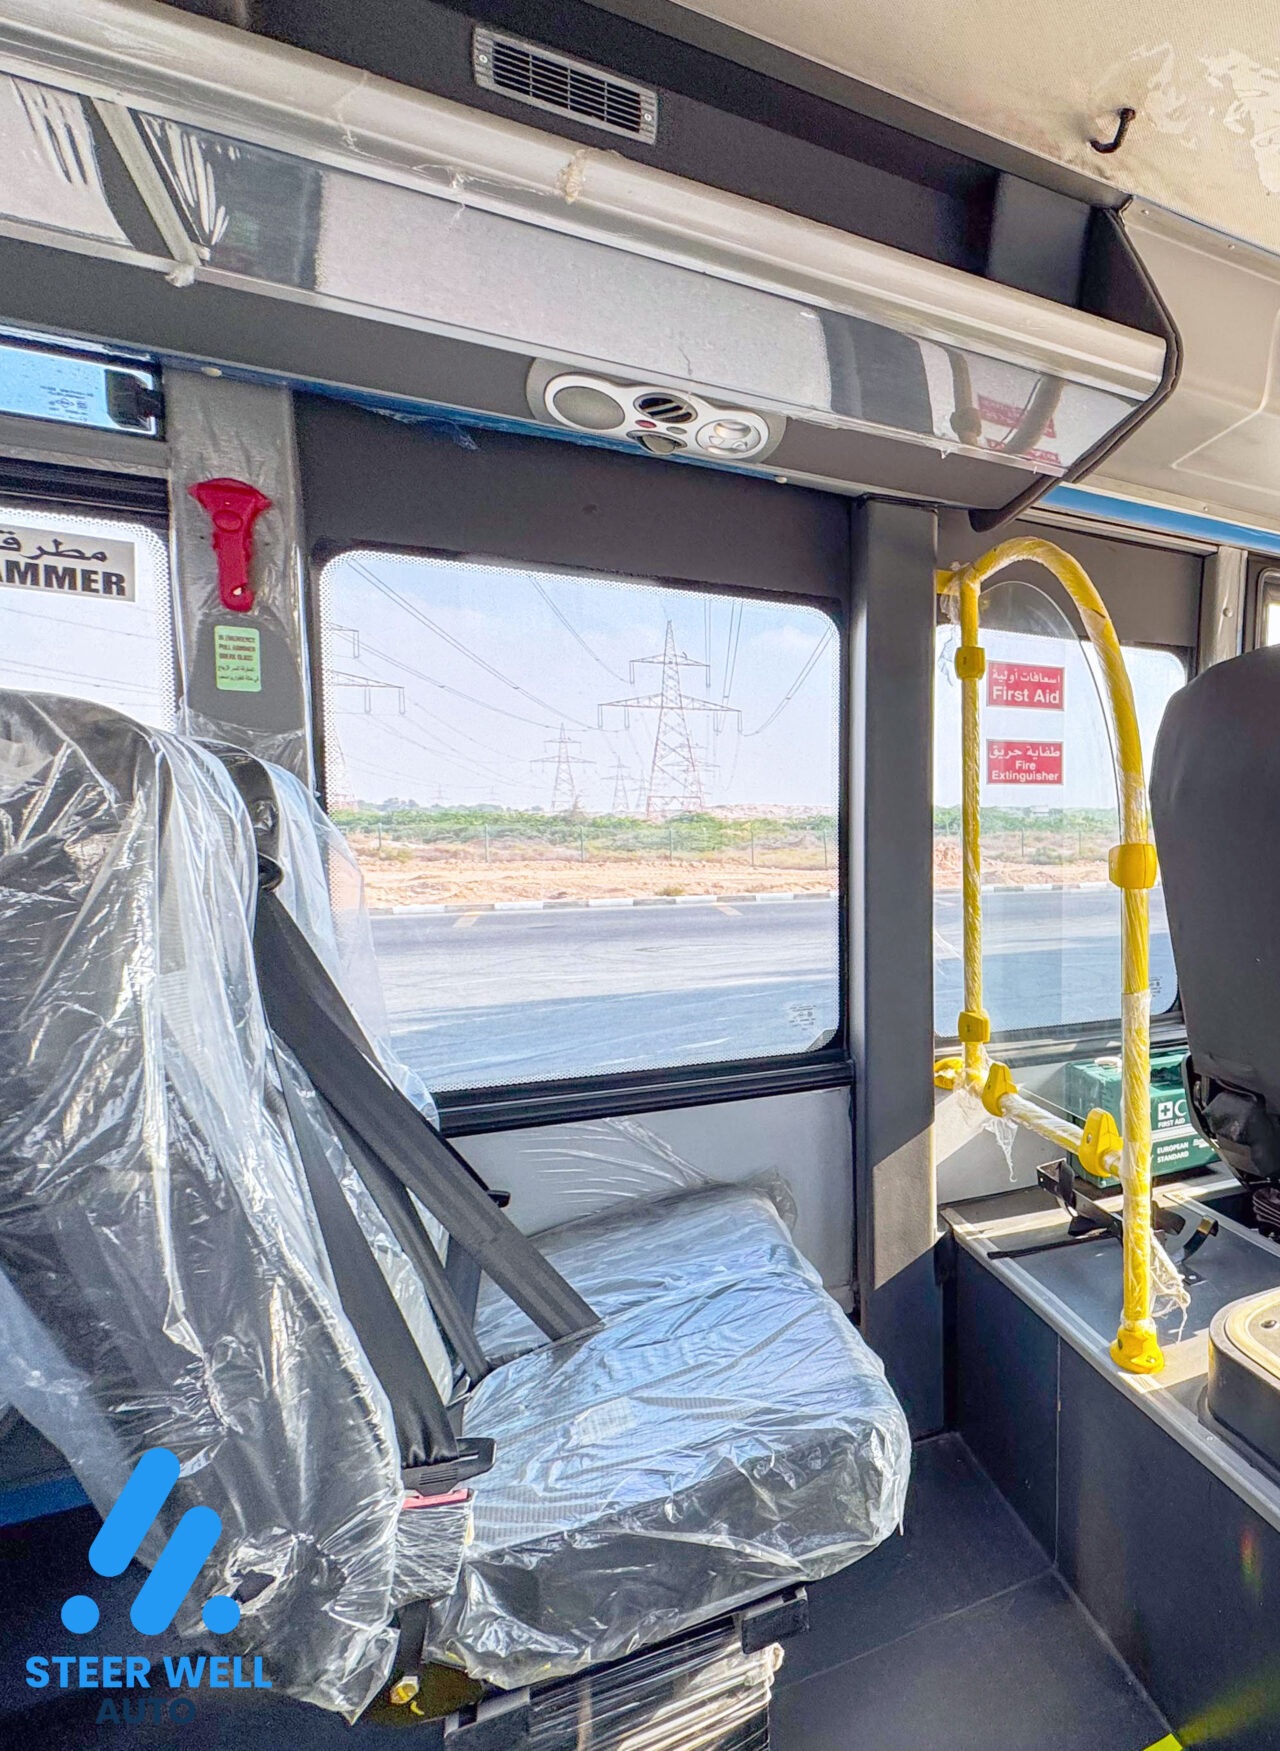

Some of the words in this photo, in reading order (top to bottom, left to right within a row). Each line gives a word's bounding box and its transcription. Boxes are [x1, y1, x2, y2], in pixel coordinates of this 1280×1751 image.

[0, 559, 126, 596] MMER
[992, 686, 1029, 702] First
[1033, 689, 1060, 704] Aid
[989, 745, 1022, 759] حريق
[1026, 745, 1060, 760] طفاية
[1015, 760, 1036, 770] Fire
[991, 770, 1059, 782] Extinguisher
[1158, 1119, 1174, 1128] FIRST
[1174, 1117, 1186, 1126] AID
[1157, 1142, 1189, 1154] EUROPEAN
[1157, 1150, 1189, 1163] STANDARD
